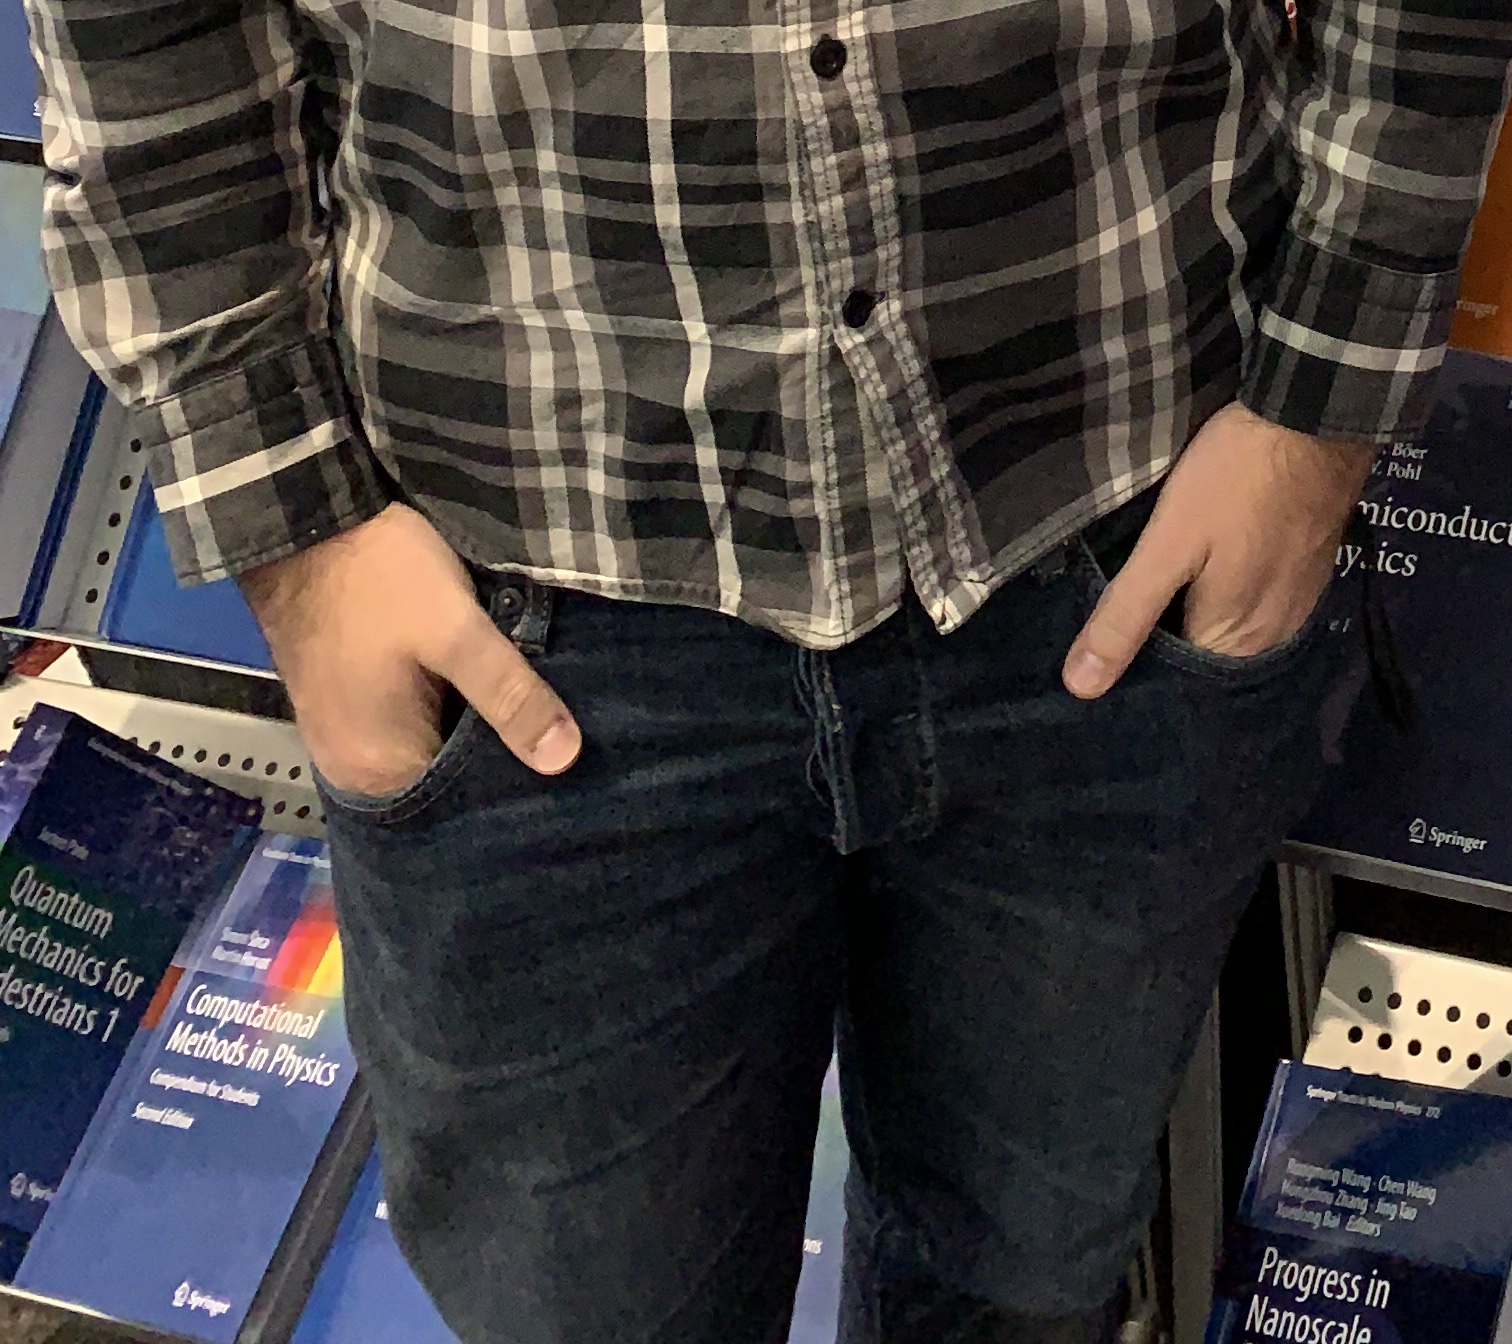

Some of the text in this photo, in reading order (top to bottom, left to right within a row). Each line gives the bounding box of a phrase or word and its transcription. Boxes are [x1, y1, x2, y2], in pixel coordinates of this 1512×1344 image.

[1427, 824, 1488, 854] Springer
[9, 864, 116, 940] Quantum
[186, 983, 326, 1041] Computational
[164, 1020, 341, 1088] Methods in Physics
[1257, 1245, 1392, 1310] Progress in
[1243, 1293, 1373, 1344] Nanoscale
